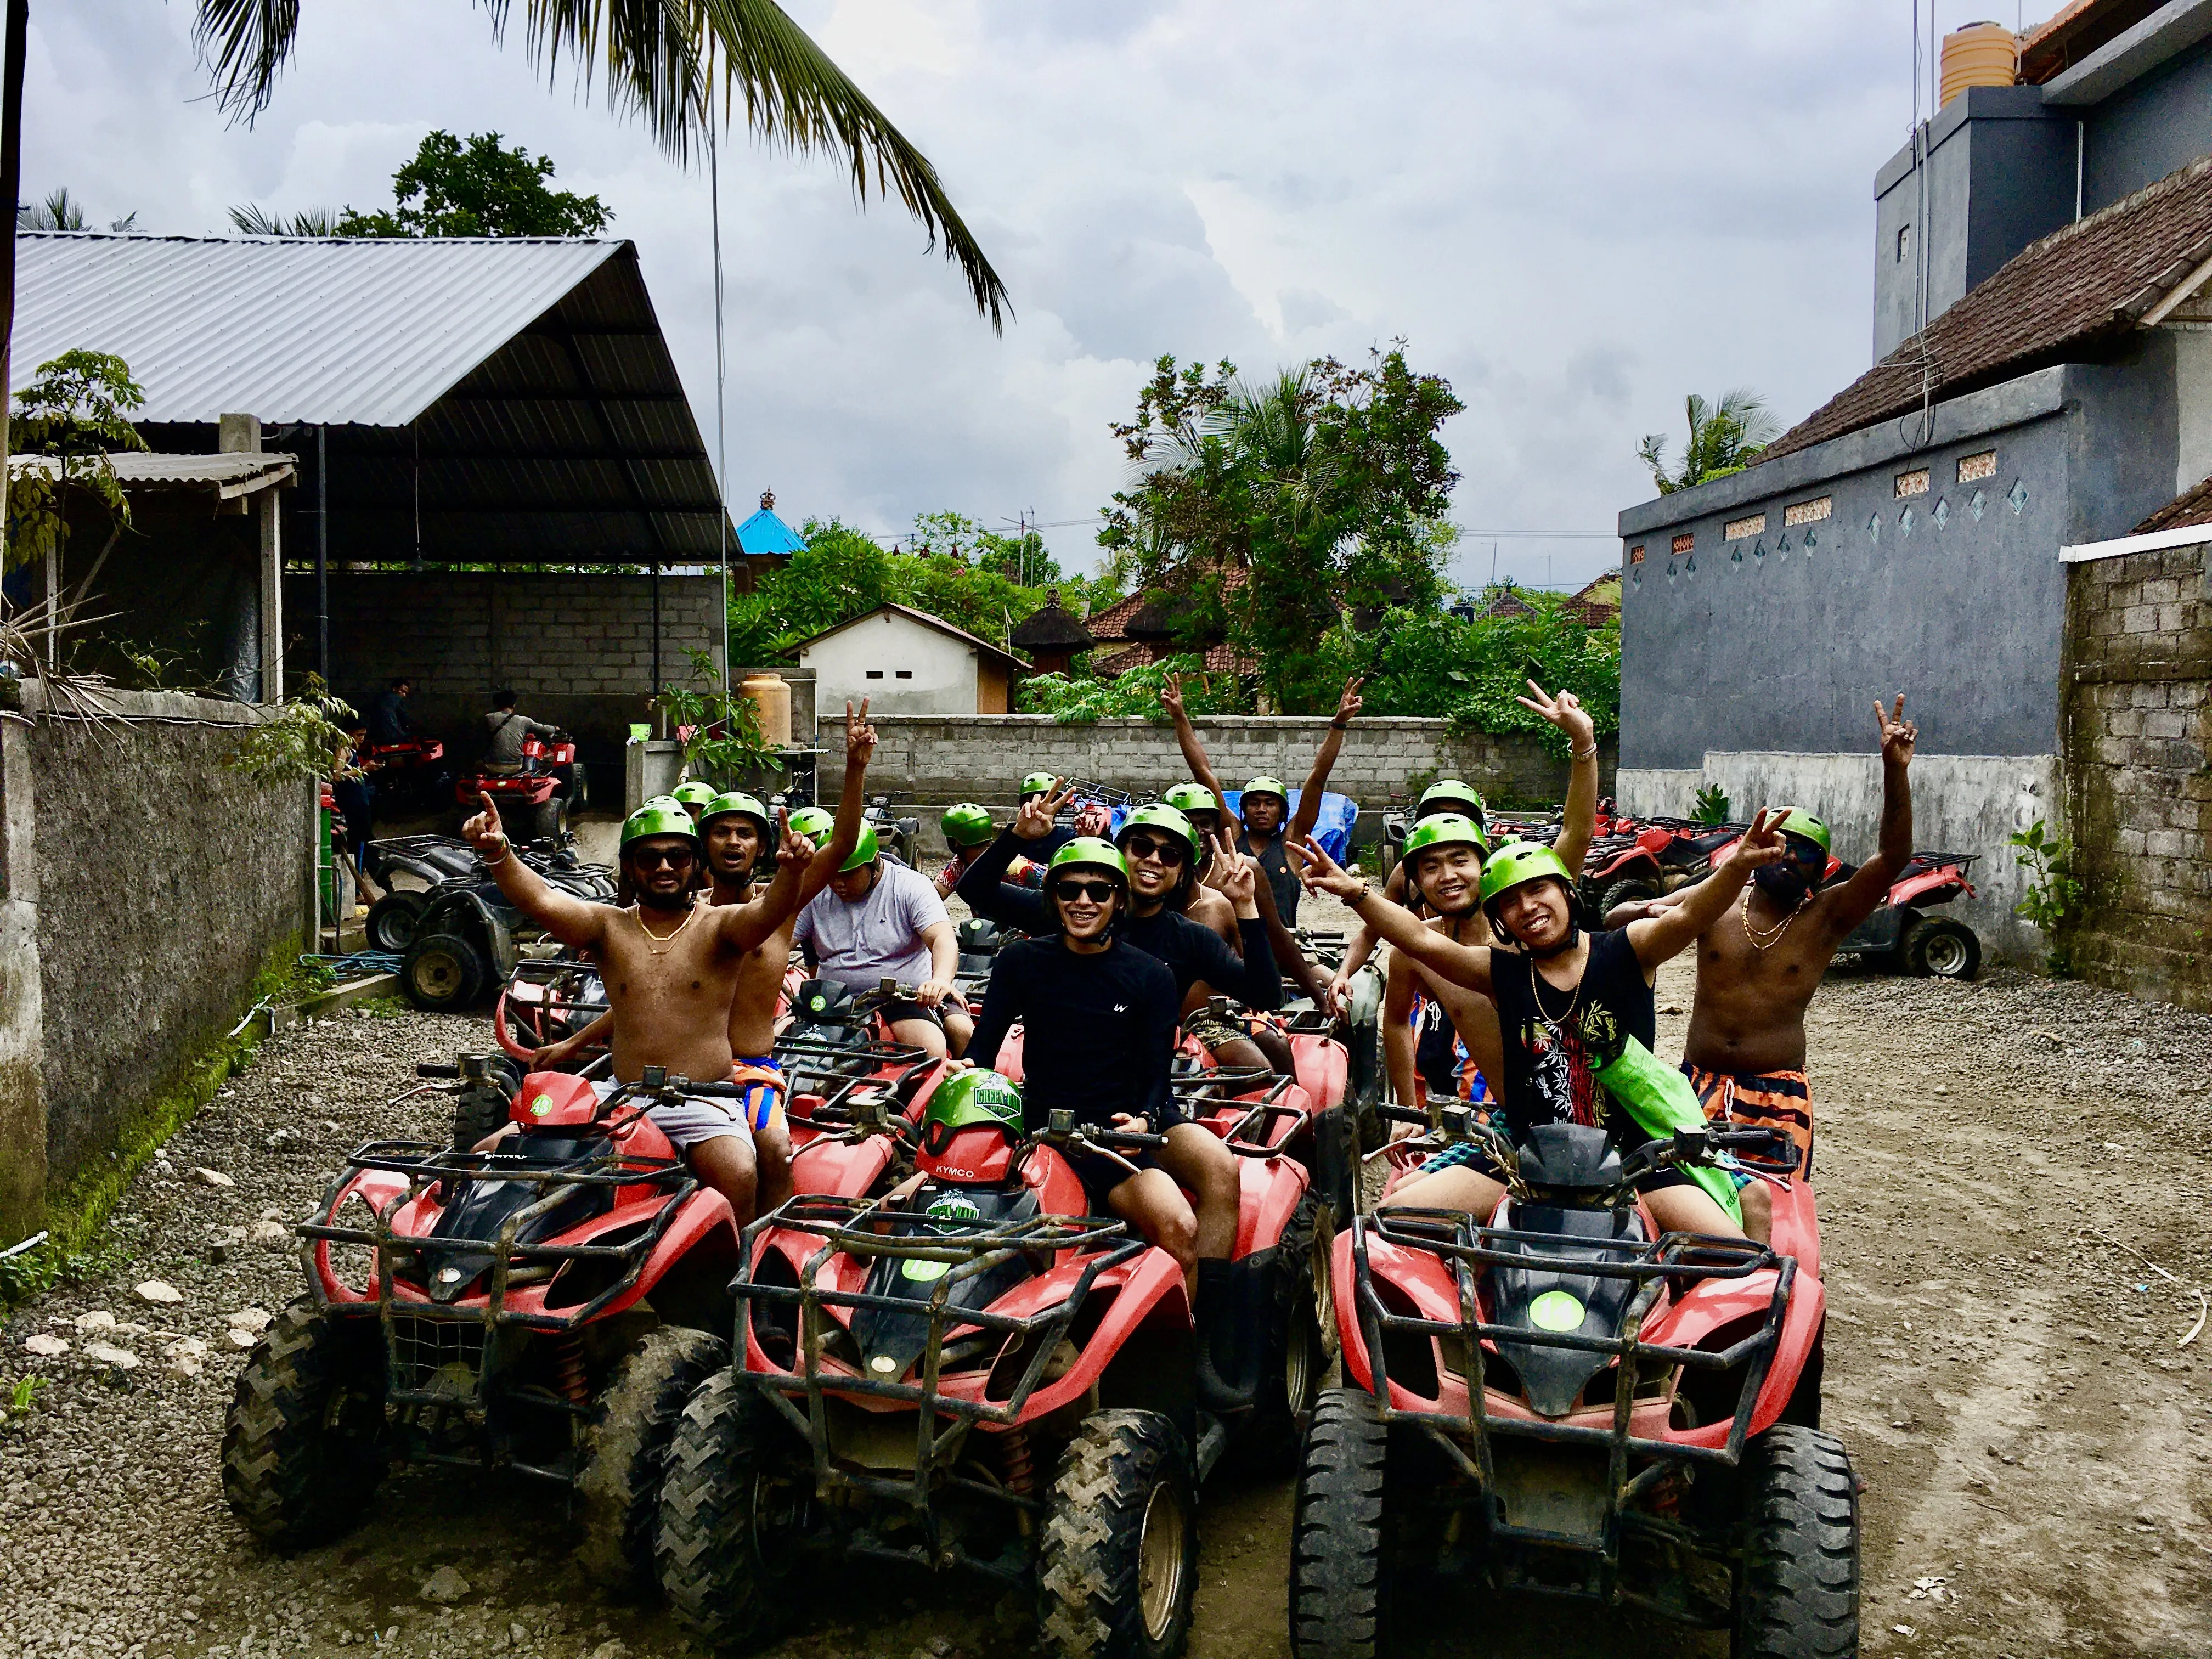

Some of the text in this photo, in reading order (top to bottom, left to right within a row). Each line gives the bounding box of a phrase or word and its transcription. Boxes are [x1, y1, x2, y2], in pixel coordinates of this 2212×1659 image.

[812, 998, 824, 1009] 25
[978, 1090, 1005, 1104] GREEN
[532, 1098, 550, 1114] 43
[936, 1165, 974, 1178] KYMCO
[1539, 1297, 1573, 1323] 14
